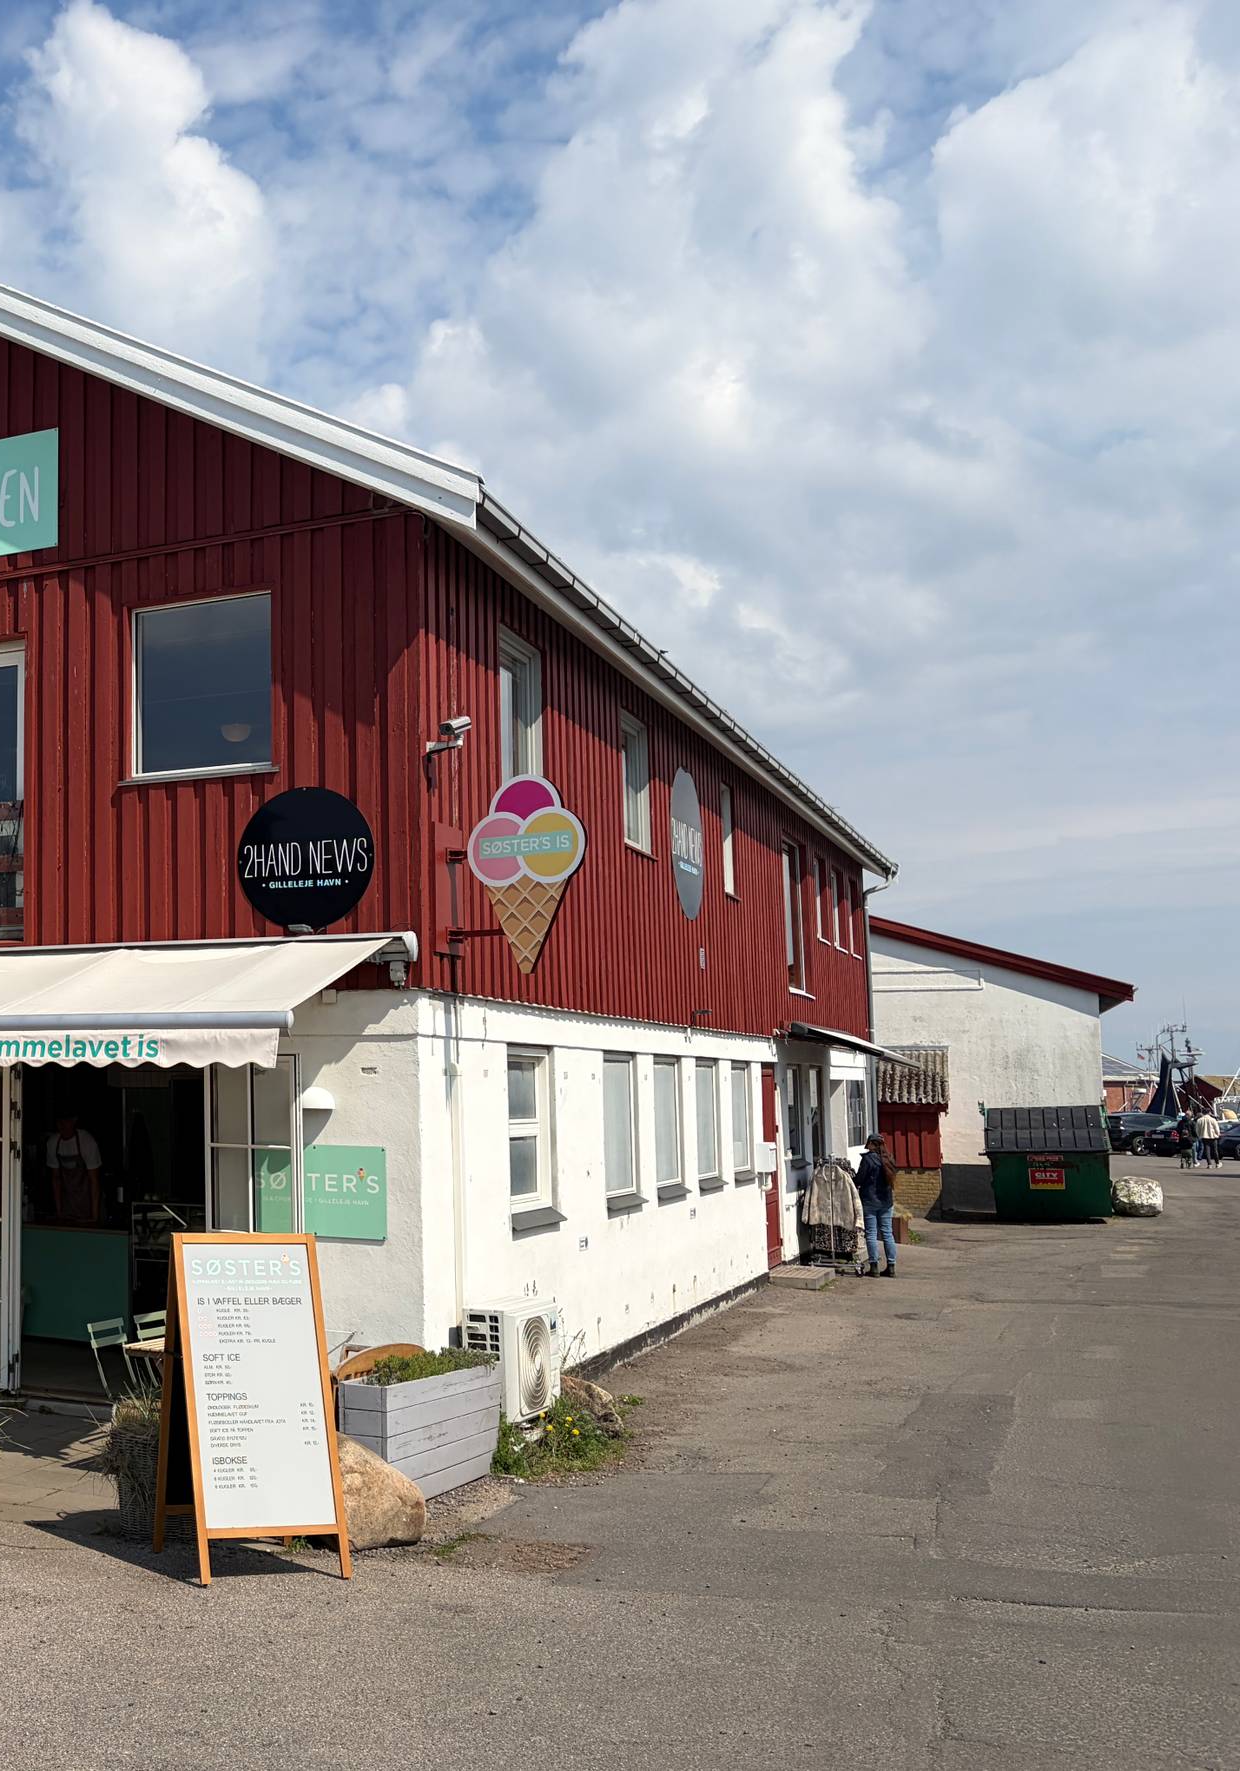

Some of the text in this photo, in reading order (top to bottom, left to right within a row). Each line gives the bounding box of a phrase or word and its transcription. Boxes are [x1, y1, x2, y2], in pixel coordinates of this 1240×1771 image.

[482, 834, 570, 855] SØSTER'S IS
[244, 837, 368, 878] 2HAND NEWS
[268, 878, 342, 889] GILLELEJE HAVN
[137, 1034, 160, 1058] is
[197, 1297, 205, 1306] IS
[212, 1297, 242, 1306] VAFFEL
[244, 1297, 269, 1306] ELLER
[272, 1296, 303, 1306] BÆGER
[202, 1353, 241, 1362] SOFT ICE
[206, 1392, 248, 1402] TOPPINGS
[212, 1455, 248, 1465] ISBOKSE
